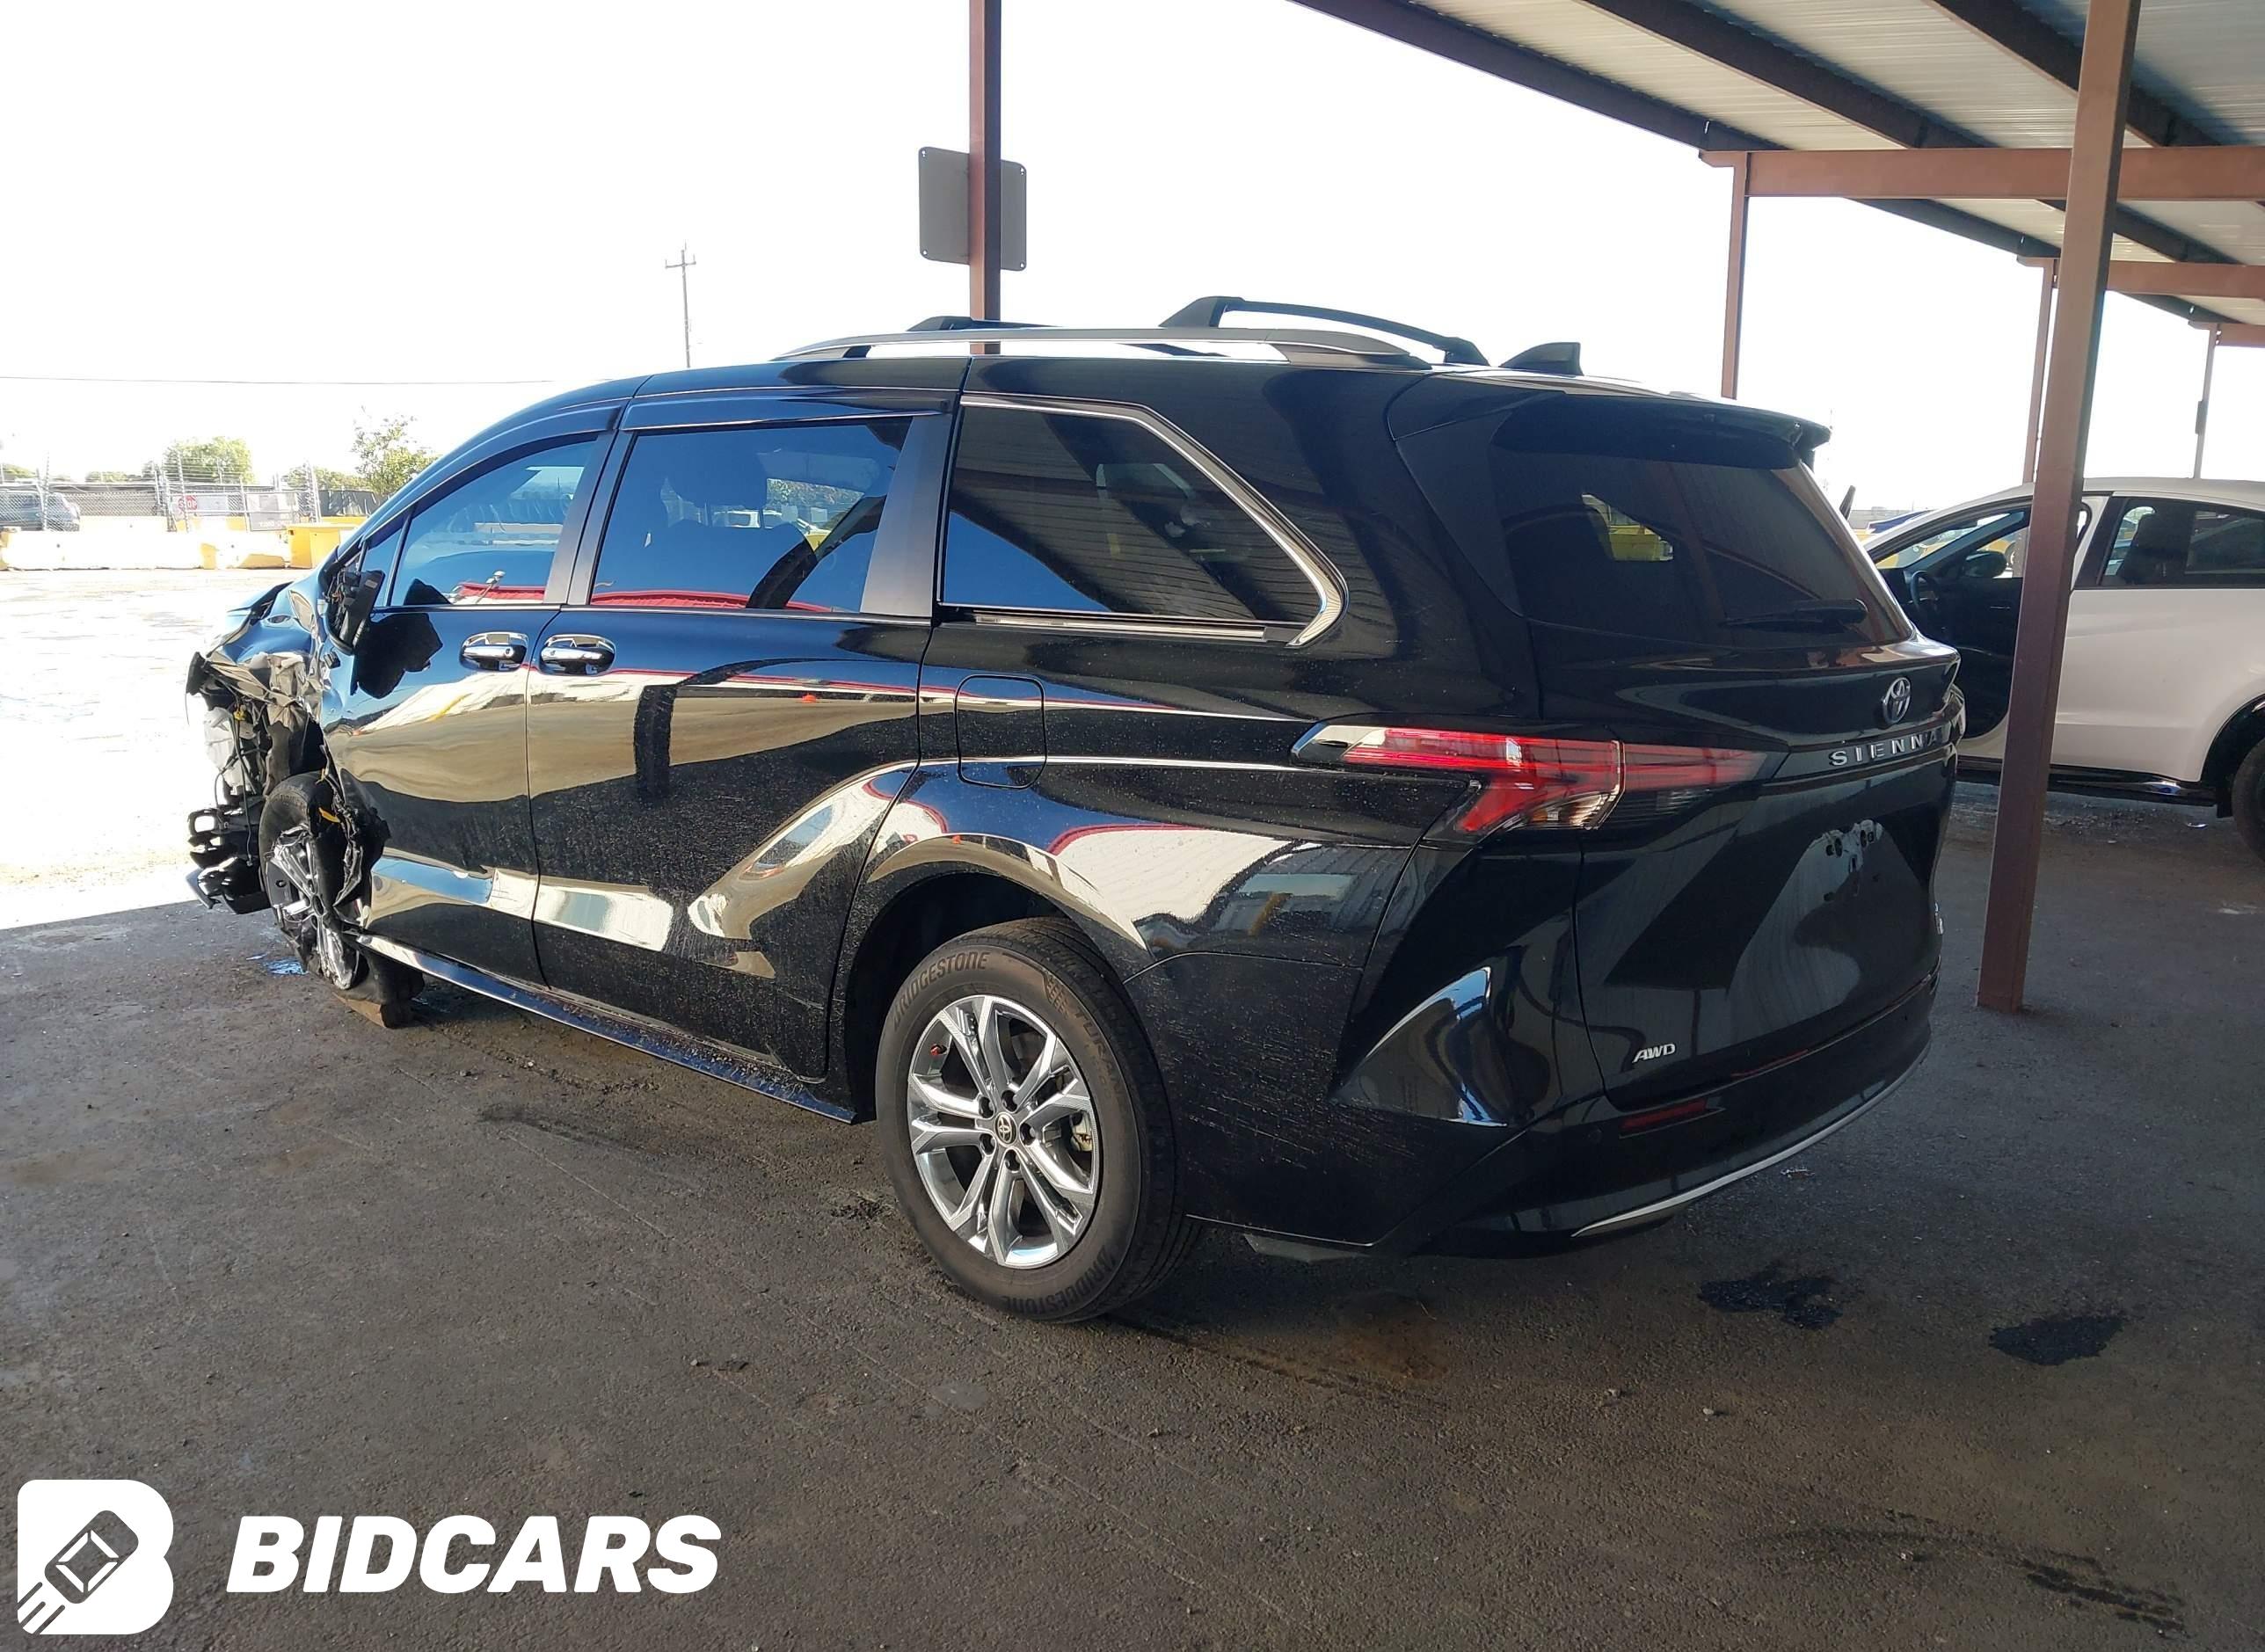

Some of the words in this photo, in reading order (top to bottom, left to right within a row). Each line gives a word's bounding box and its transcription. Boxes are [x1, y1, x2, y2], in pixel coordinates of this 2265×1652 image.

[178, 497, 198, 511] SOP
[1829, 729, 1941, 766] SIENNA
[893, 951, 991, 1032] BRIDGESTONE
[1632, 1043, 1676, 1064] AWD
